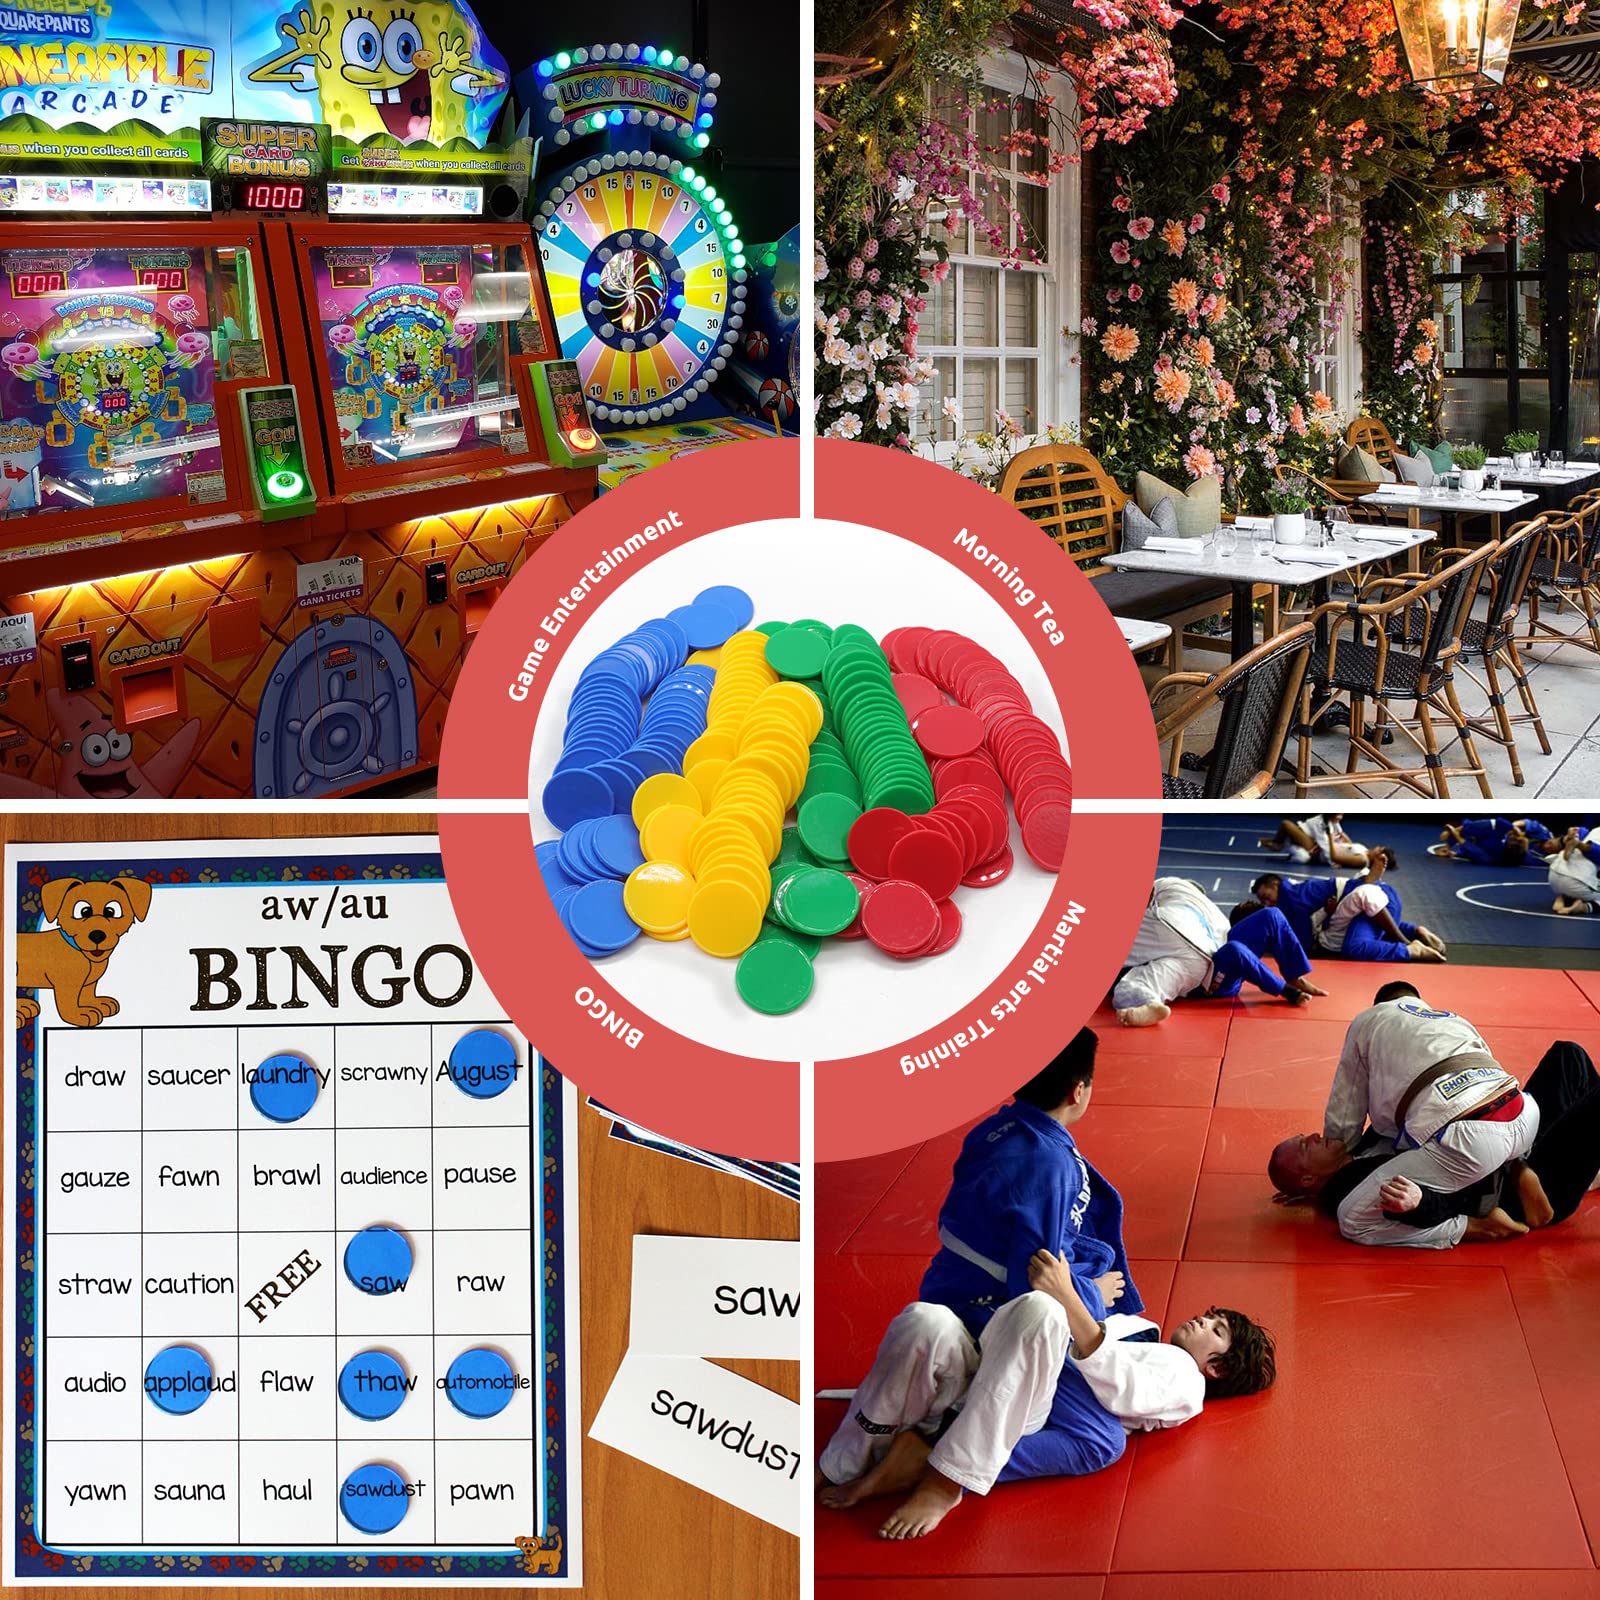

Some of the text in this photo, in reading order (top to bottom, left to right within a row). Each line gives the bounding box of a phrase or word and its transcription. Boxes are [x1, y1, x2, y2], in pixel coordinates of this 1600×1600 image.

[11, 90, 174, 115] ARCADE
[560, 76, 689, 110] LUCKY TURNING
[216, 122, 318, 151] SUPER
[23, 142, 60, 154] when
[64, 145, 88, 156] you
[92, 145, 133, 156] collect
[136, 146, 151, 157] all
[155, 148, 189, 158] cards
[243, 145, 294, 160] CARD
[228, 154, 312, 178] BONUS
[342, 156, 360, 165] Get
[416, 159, 440, 169] when
[442, 162, 458, 171] you
[460, 162, 489, 171] collect
[490, 163, 501, 171] all
[502, 164, 526, 172] cards
[584, 188, 596, 198] 10
[607, 179, 618, 189] 15
[641, 179, 652, 189] 15
[662, 187, 674, 197] 10
[247, 186, 303, 208] 1000
[683, 202, 689, 211] 7
[567, 202, 573, 213] 7
[550, 225, 557, 235] 4
[698, 220, 704, 230] 4
[706, 243, 717, 253] 15
[4, 257, 73, 271] TICKETS
[712, 269, 722, 278] 10
[18, 275, 61, 293] 000
[143, 271, 182, 289] 000
[714, 293, 721, 303] 7
[707, 319, 719, 329] 30
[699, 342, 706, 352] 4
[686, 362, 693, 372] 7
[590, 386, 602, 396] 10
[667, 378, 678, 387] 10
[104, 399, 127, 409] 000
[613, 394, 624, 402] 15
[646, 391, 657, 399] 15
[358, 445, 371, 456] 50
[457, 562, 507, 583] CARD OUT
[300, 588, 361, 607] GANA TICKETS
[1, 615, 27, 628] AQUÍ
[110, 638, 181, 664] CARD OUT
[260, 886, 389, 928] aw/au
[189, 943, 474, 1012] BINGO
[64, 1065, 126, 1087] draw
[147, 1067, 231, 1086] saucer
[241, 1061, 331, 1093] laundry
[340, 1063, 429, 1086] scrawny
[435, 1060, 524, 1087] August
[60, 1170, 131, 1194] gauze
[158, 1165, 220, 1187] fawn
[253, 1163, 321, 1187] brawl
[340, 1166, 428, 1185] audience
[444, 1165, 517, 1190] pause
[58, 1272, 133, 1296] straw
[144, 1271, 234, 1295] caution
[244, 1249, 322, 1324] FREE
[360, 1274, 409, 1294] saw
[457, 1273, 506, 1292] raw
[714, 1285, 800, 1318] saw
[64, 1370, 127, 1394] audio
[143, 1371, 236, 1398] applaud
[259, 1370, 314, 1393] flaw
[353, 1370, 418, 1393] thaw
[436, 1373, 531, 1391] automobile
[64, 1484, 127, 1507] yawn
[154, 1482, 226, 1502] sauna
[262, 1478, 312, 1501] haul
[345, 1479, 427, 1498] sawdust
[450, 1480, 514, 1507] pawn
